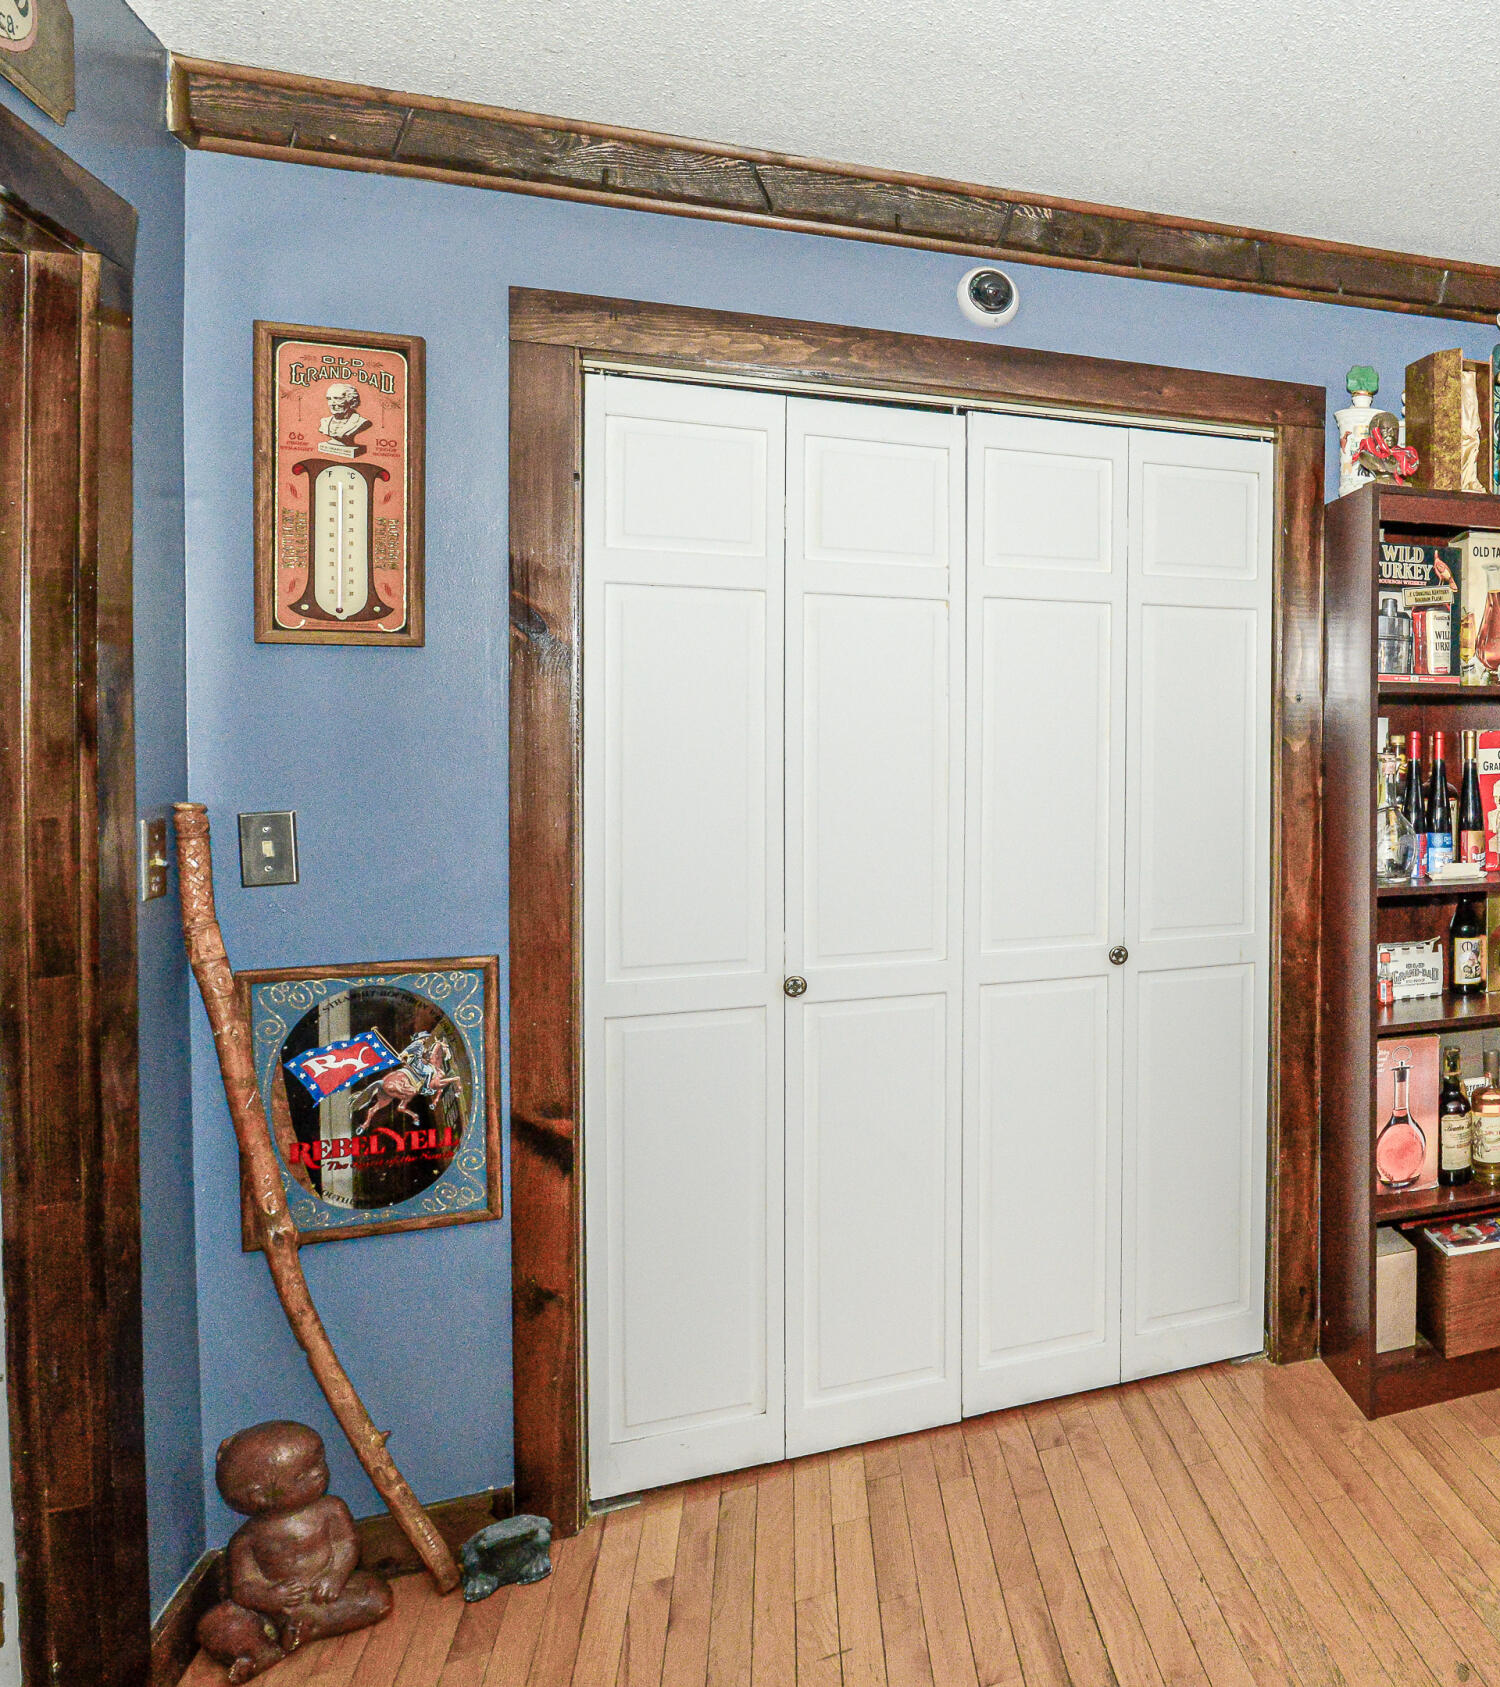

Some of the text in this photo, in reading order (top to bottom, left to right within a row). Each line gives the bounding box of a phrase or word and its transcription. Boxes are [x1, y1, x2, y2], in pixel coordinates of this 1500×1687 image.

[321, 355, 365, 367] OLD
[375, 438, 398, 447] 100
[1381, 545, 1425, 563] WILD
[1472, 546, 1490, 558] OLD
[303, 1046, 370, 1078] RY
[289, 1127, 461, 1170] REBEL YELL
[327, 1161, 350, 1171] The
